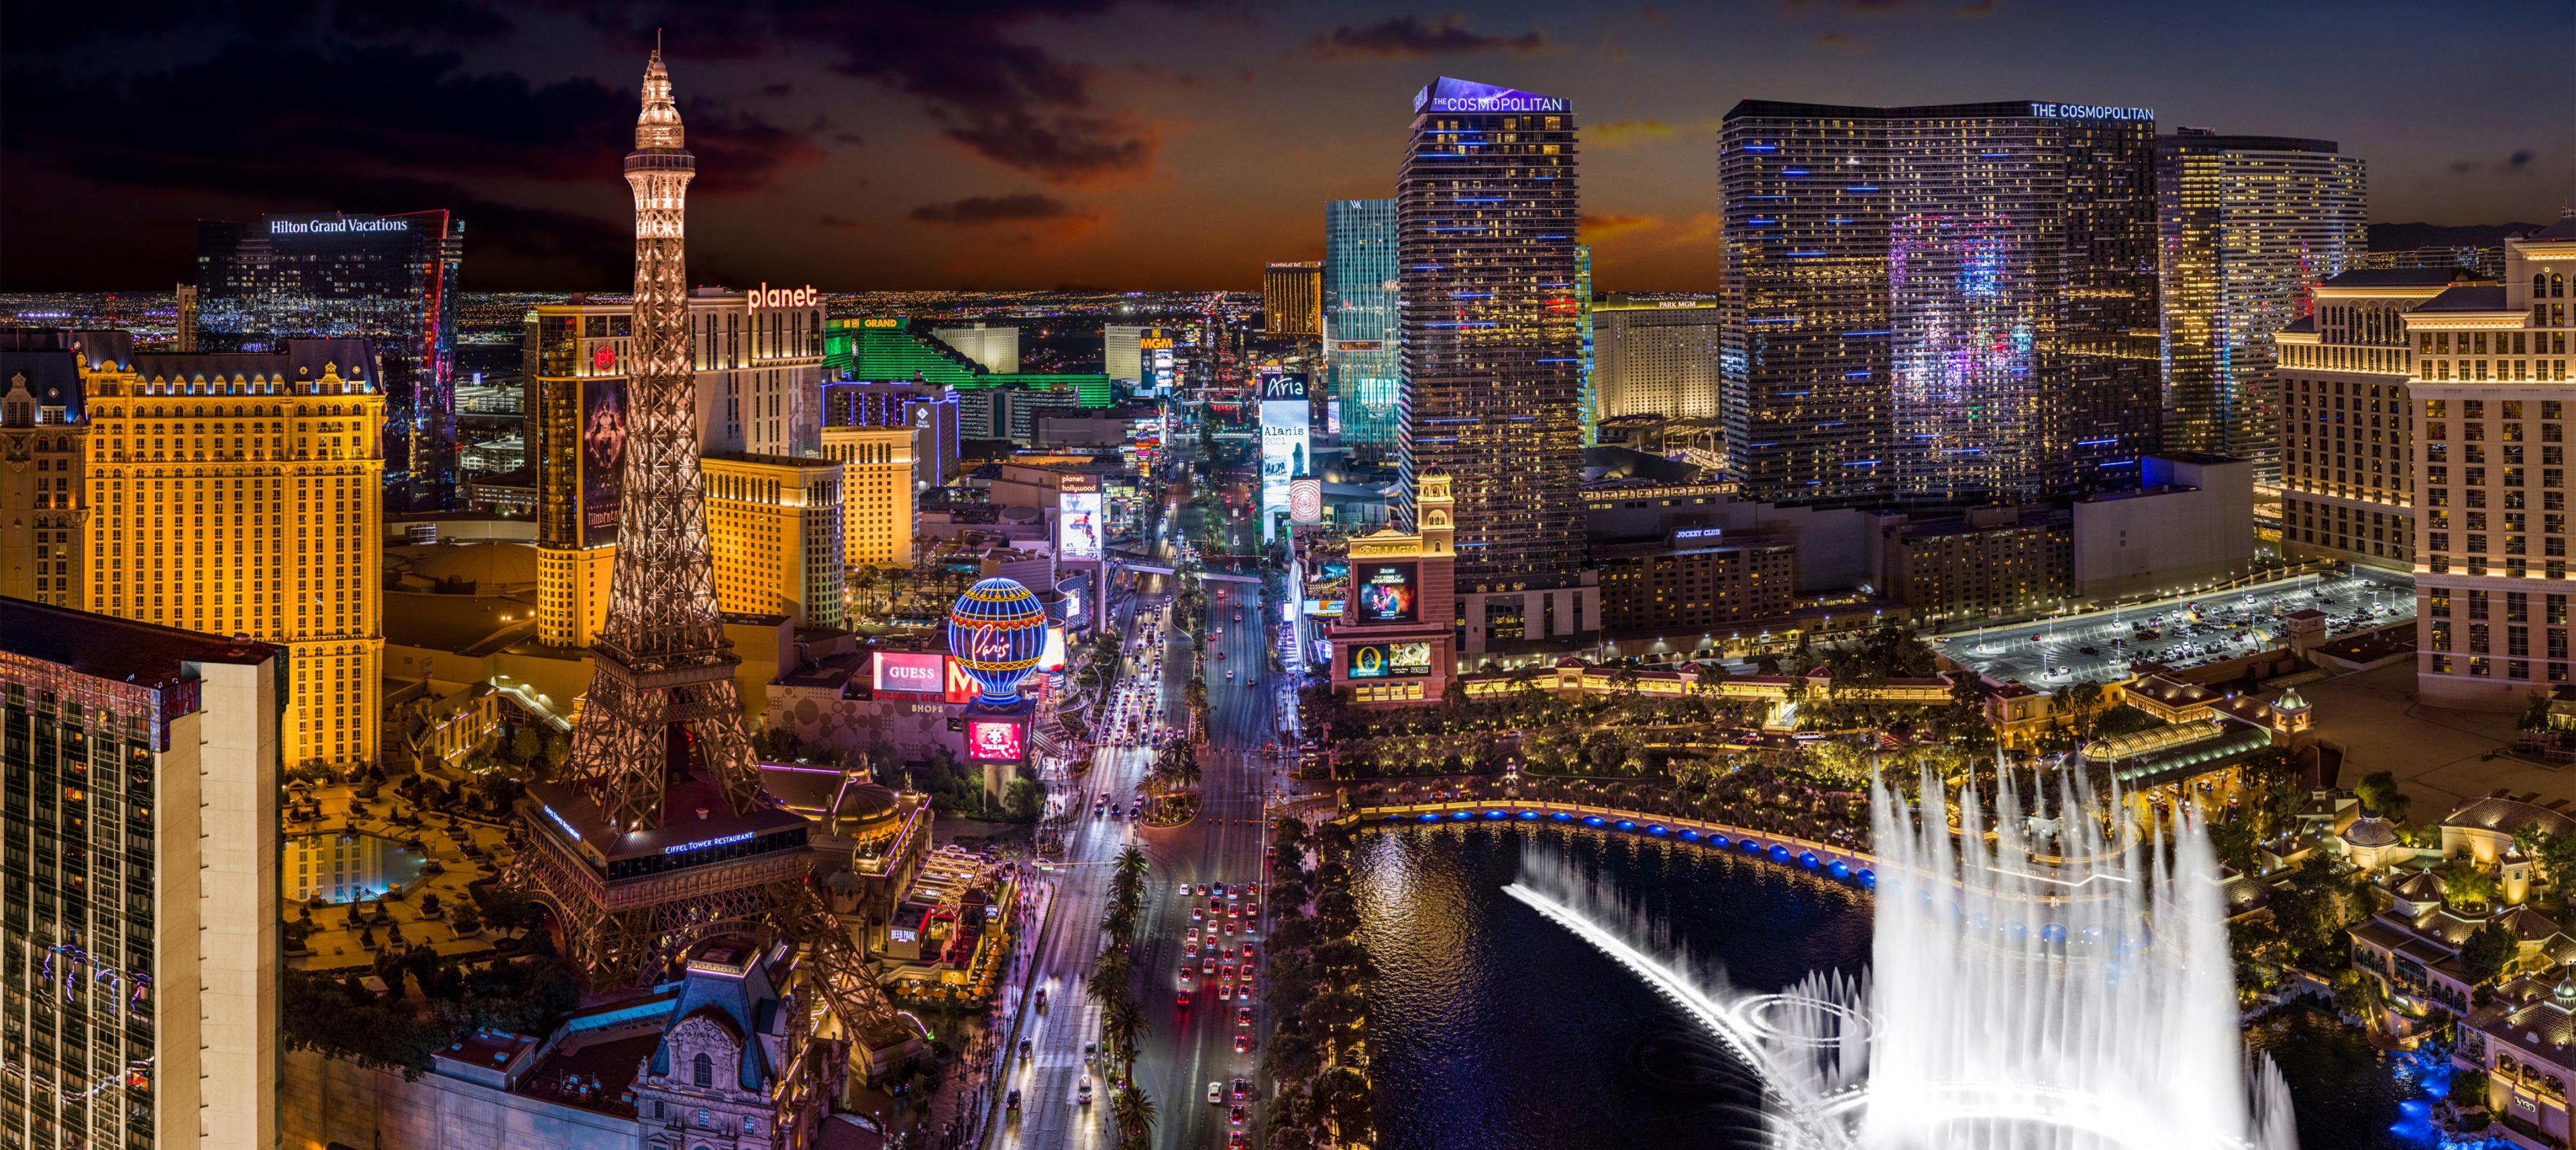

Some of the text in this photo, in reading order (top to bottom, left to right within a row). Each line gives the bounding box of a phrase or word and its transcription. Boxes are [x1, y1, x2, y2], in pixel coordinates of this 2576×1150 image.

[1448, 97, 1562, 111] COSMOPOLITAN
[2031, 104, 2154, 121] THE COSMOPOLITAN
[271, 218, 408, 233] Hilton Grand Vacations
[747, 281, 817, 316] planet
[864, 319, 898, 327] GRAND
[1140, 337, 1174, 349] MGM
[1267, 377, 1303, 397] Aria
[1265, 426, 1304, 436] Alanis
[1265, 437, 1287, 446] 2021
[1062, 475, 1085, 484] planet
[1062, 484, 1096, 492] hollywood
[1359, 545, 1419, 556] BELLAGIO
[971, 623, 1010, 669] Paris
[889, 666, 934, 679] GUESS
[873, 691, 944, 703] MIRACLE MILE
[911, 704, 944, 713] SHOPS
[665, 831, 755, 855] EIFFEL TOWER RESTAURANT
[891, 929, 916, 942] BEER PARK
[2514, 1096, 2536, 1113] LAGO
